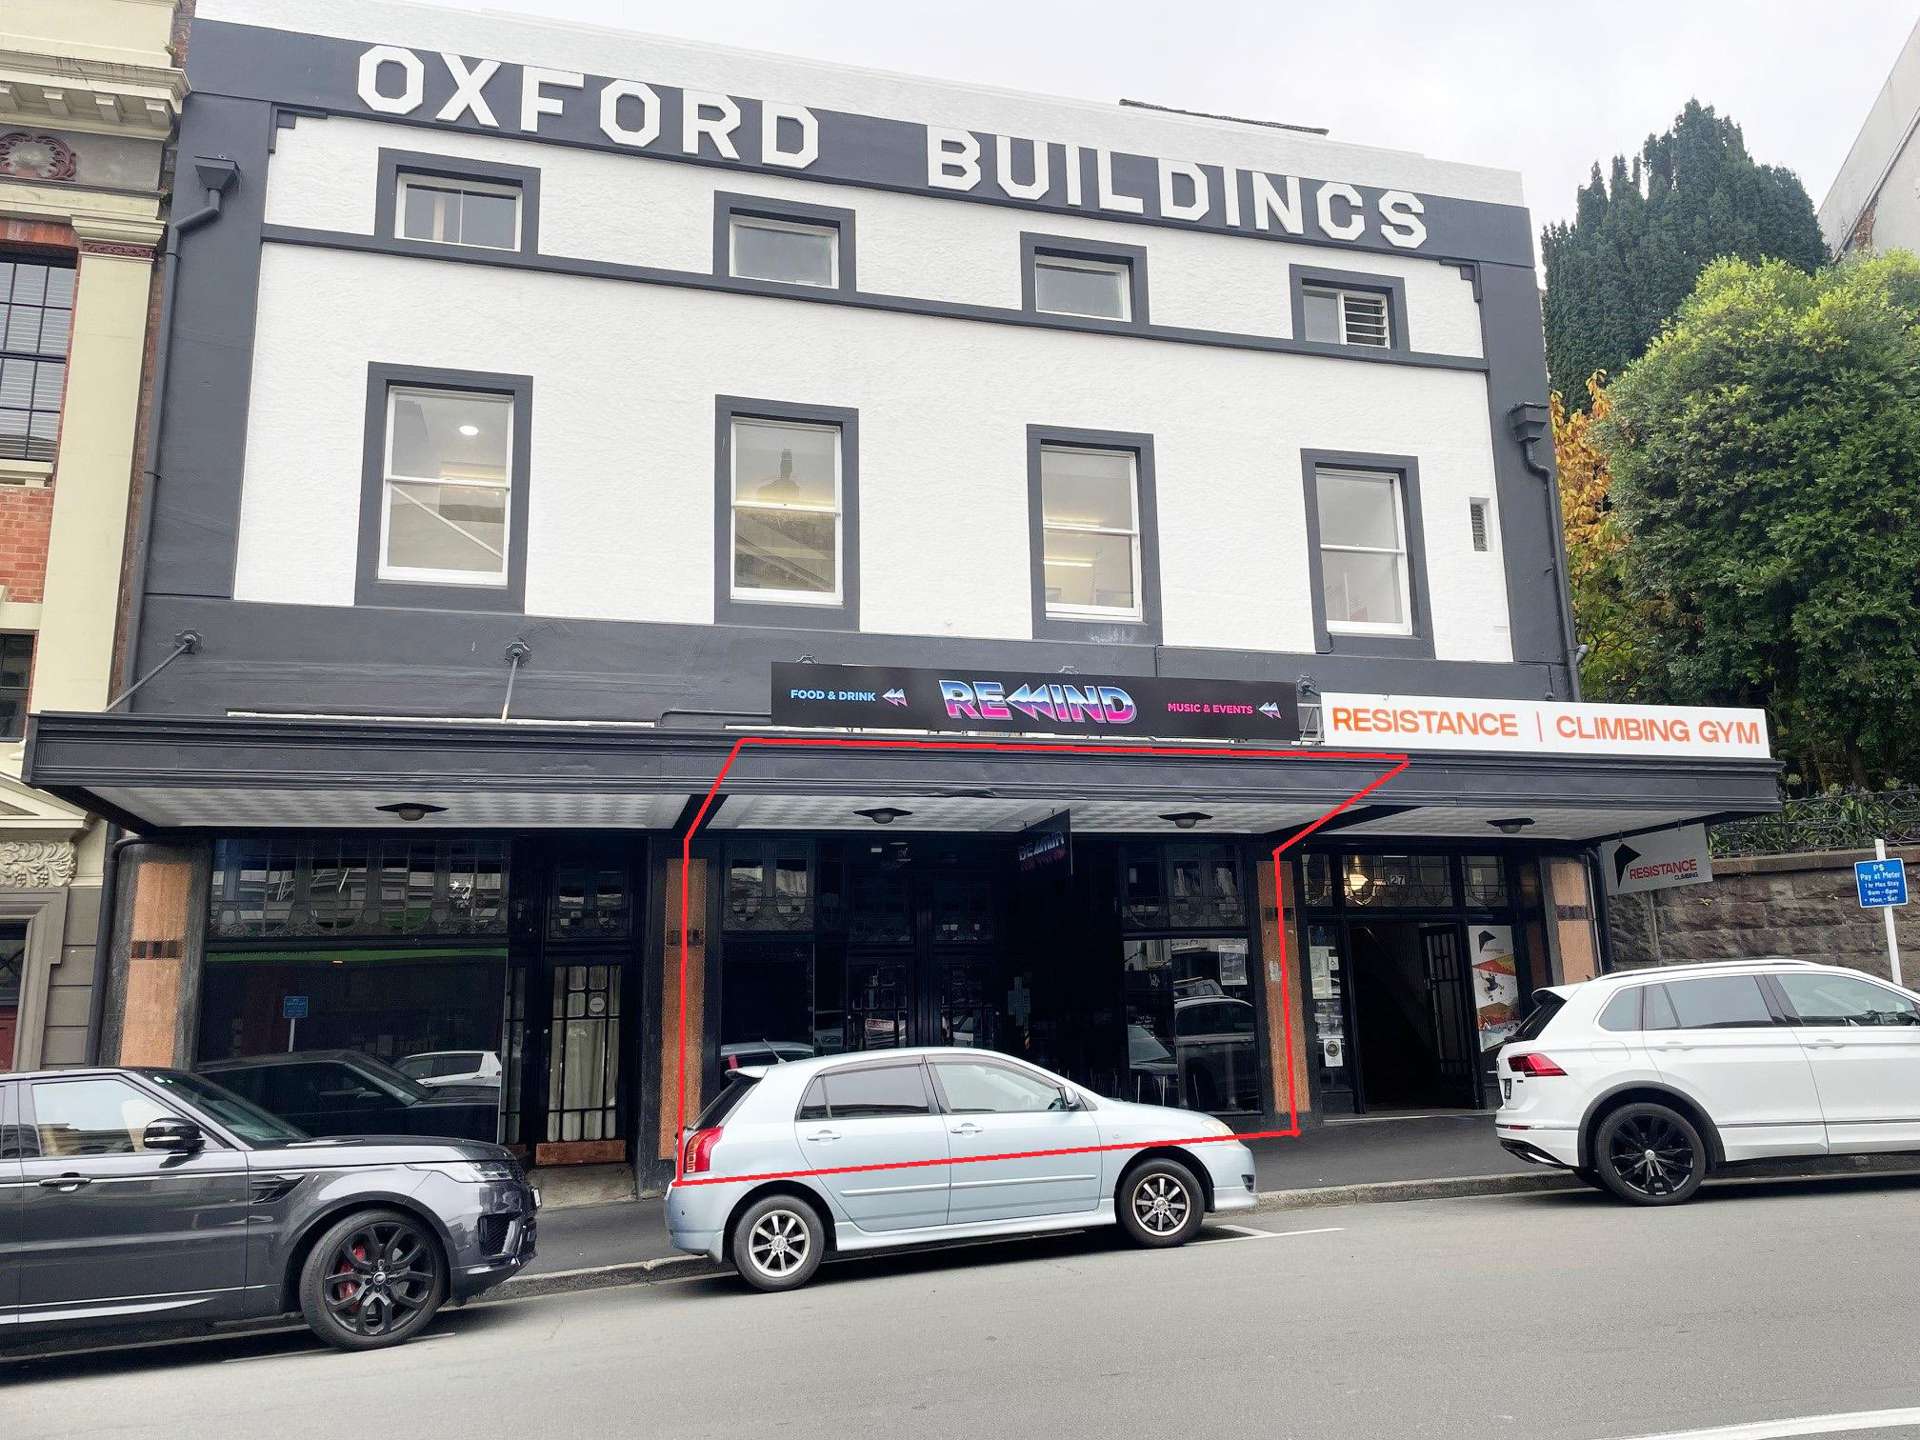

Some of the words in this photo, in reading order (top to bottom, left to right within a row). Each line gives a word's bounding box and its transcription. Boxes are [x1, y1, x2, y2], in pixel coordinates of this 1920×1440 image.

[357, 44, 820, 170] OXFORD
[790, 689, 825, 700] FOOD
[827, 690, 836, 700] &
[838, 691, 876, 701] DRINK
[1167, 703, 1201, 713] MUSIC
[1203, 703, 1211, 713] &
[1212, 704, 1254, 714] EVENTS
[1332, 706, 1519, 737] RESISTANCE
[1556, 715, 1691, 742] CLIMBING
[1698, 720, 1760, 745] GYM
[1629, 859, 1697, 880] RESISTANCE
[1860, 873, 1871, 881] Pay
[1882, 871, 1900, 879] Meter
